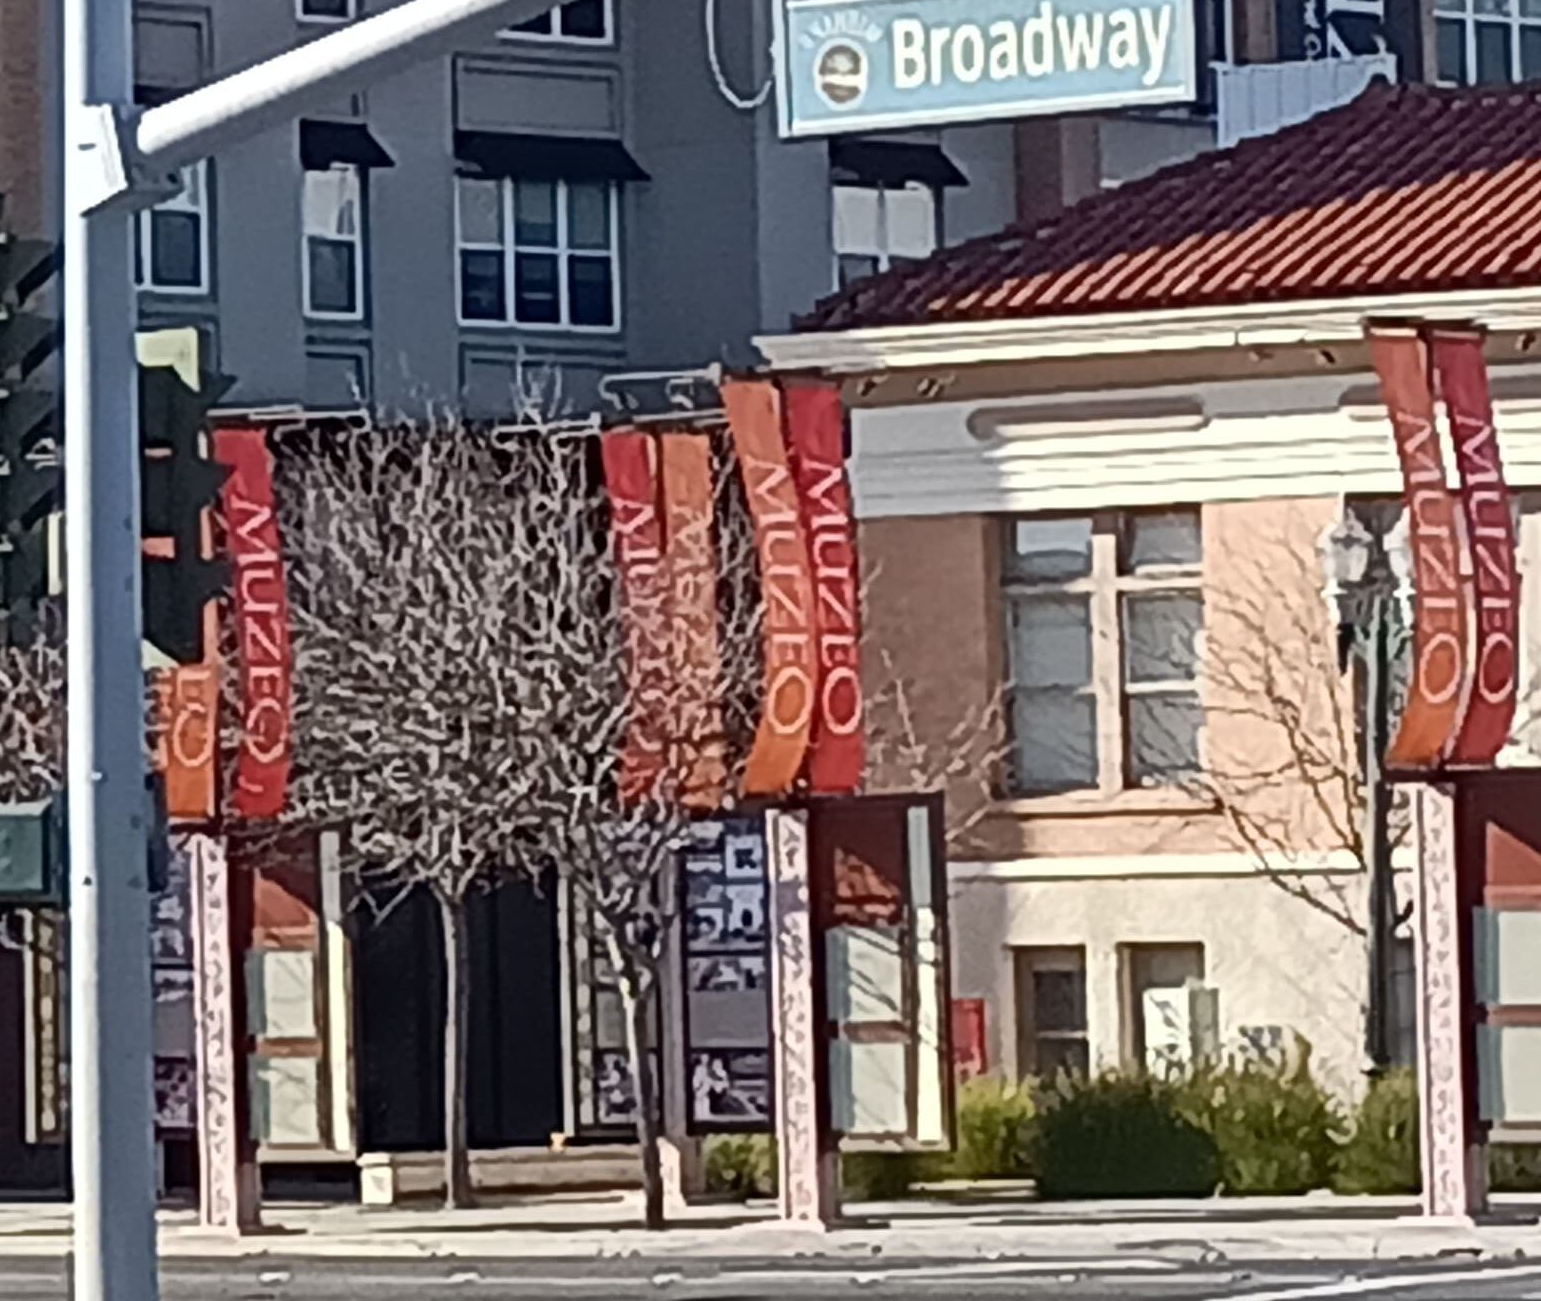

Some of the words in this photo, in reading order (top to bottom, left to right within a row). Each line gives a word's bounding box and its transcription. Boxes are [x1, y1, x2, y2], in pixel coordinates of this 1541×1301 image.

[892, 1, 1172, 89] Broadway
[230, 494, 288, 764] MUZEO
[742, 455, 813, 734] MUZEO
[802, 458, 863, 735] MUZEO
